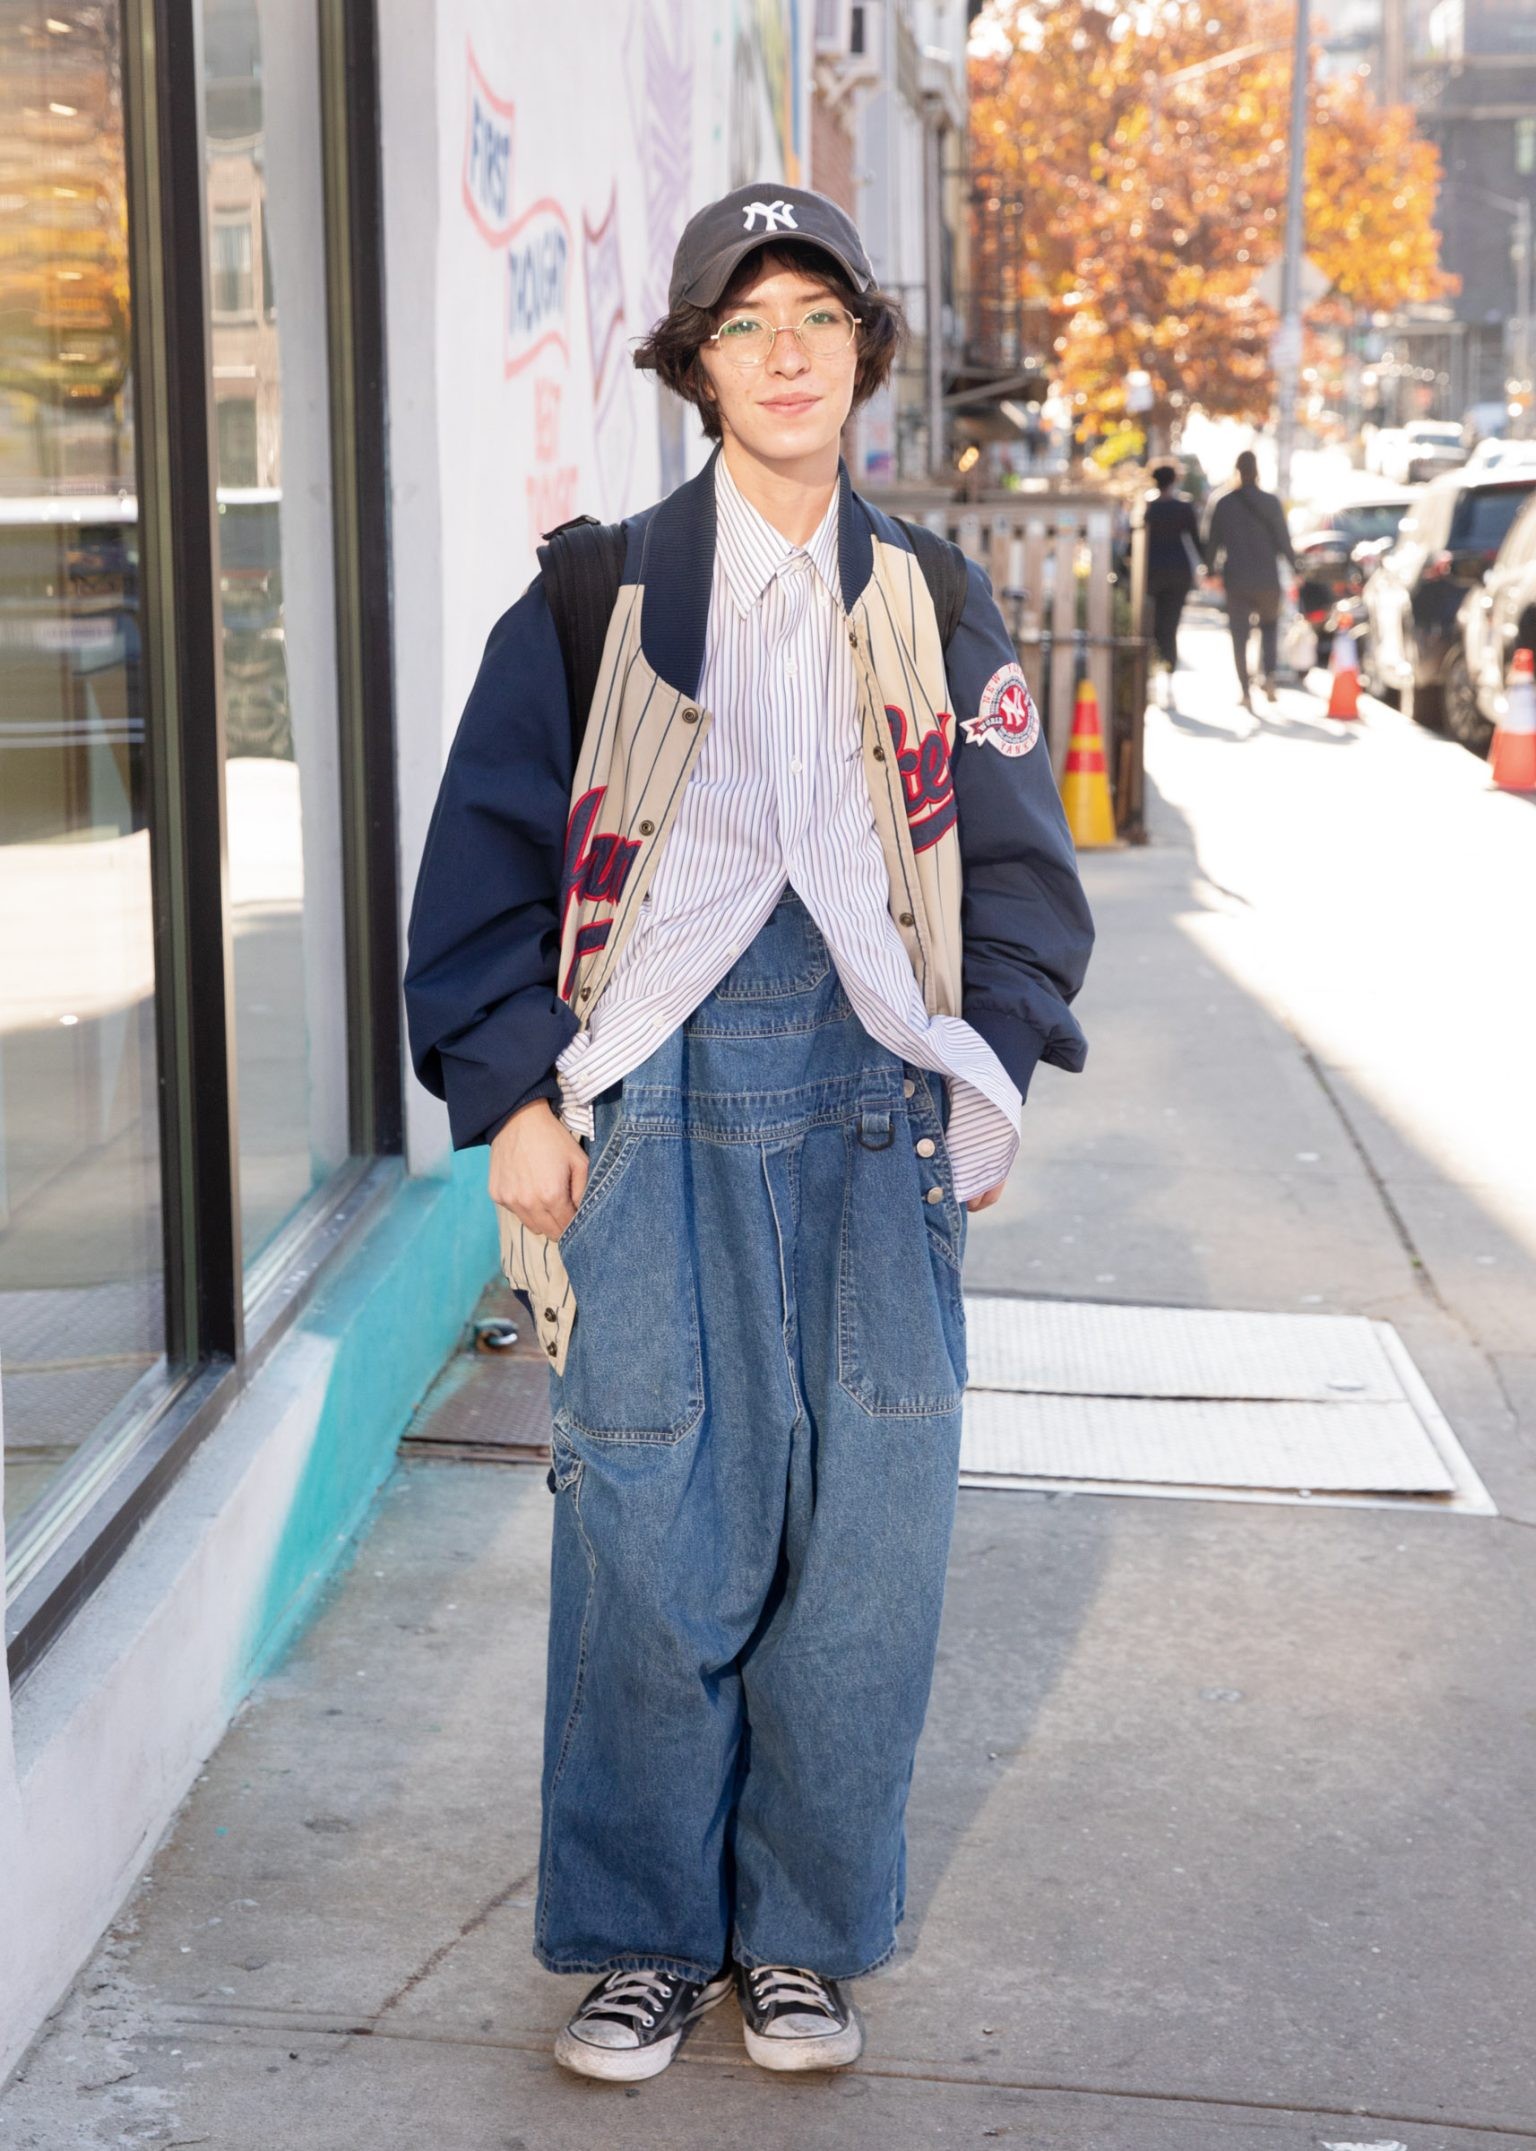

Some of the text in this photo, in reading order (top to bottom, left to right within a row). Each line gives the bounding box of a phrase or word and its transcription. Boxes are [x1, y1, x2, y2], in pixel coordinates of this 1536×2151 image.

[742, 200, 799, 231] NY
[982, 671, 1001, 704] NEW
[1000, 686, 1026, 728] NY
